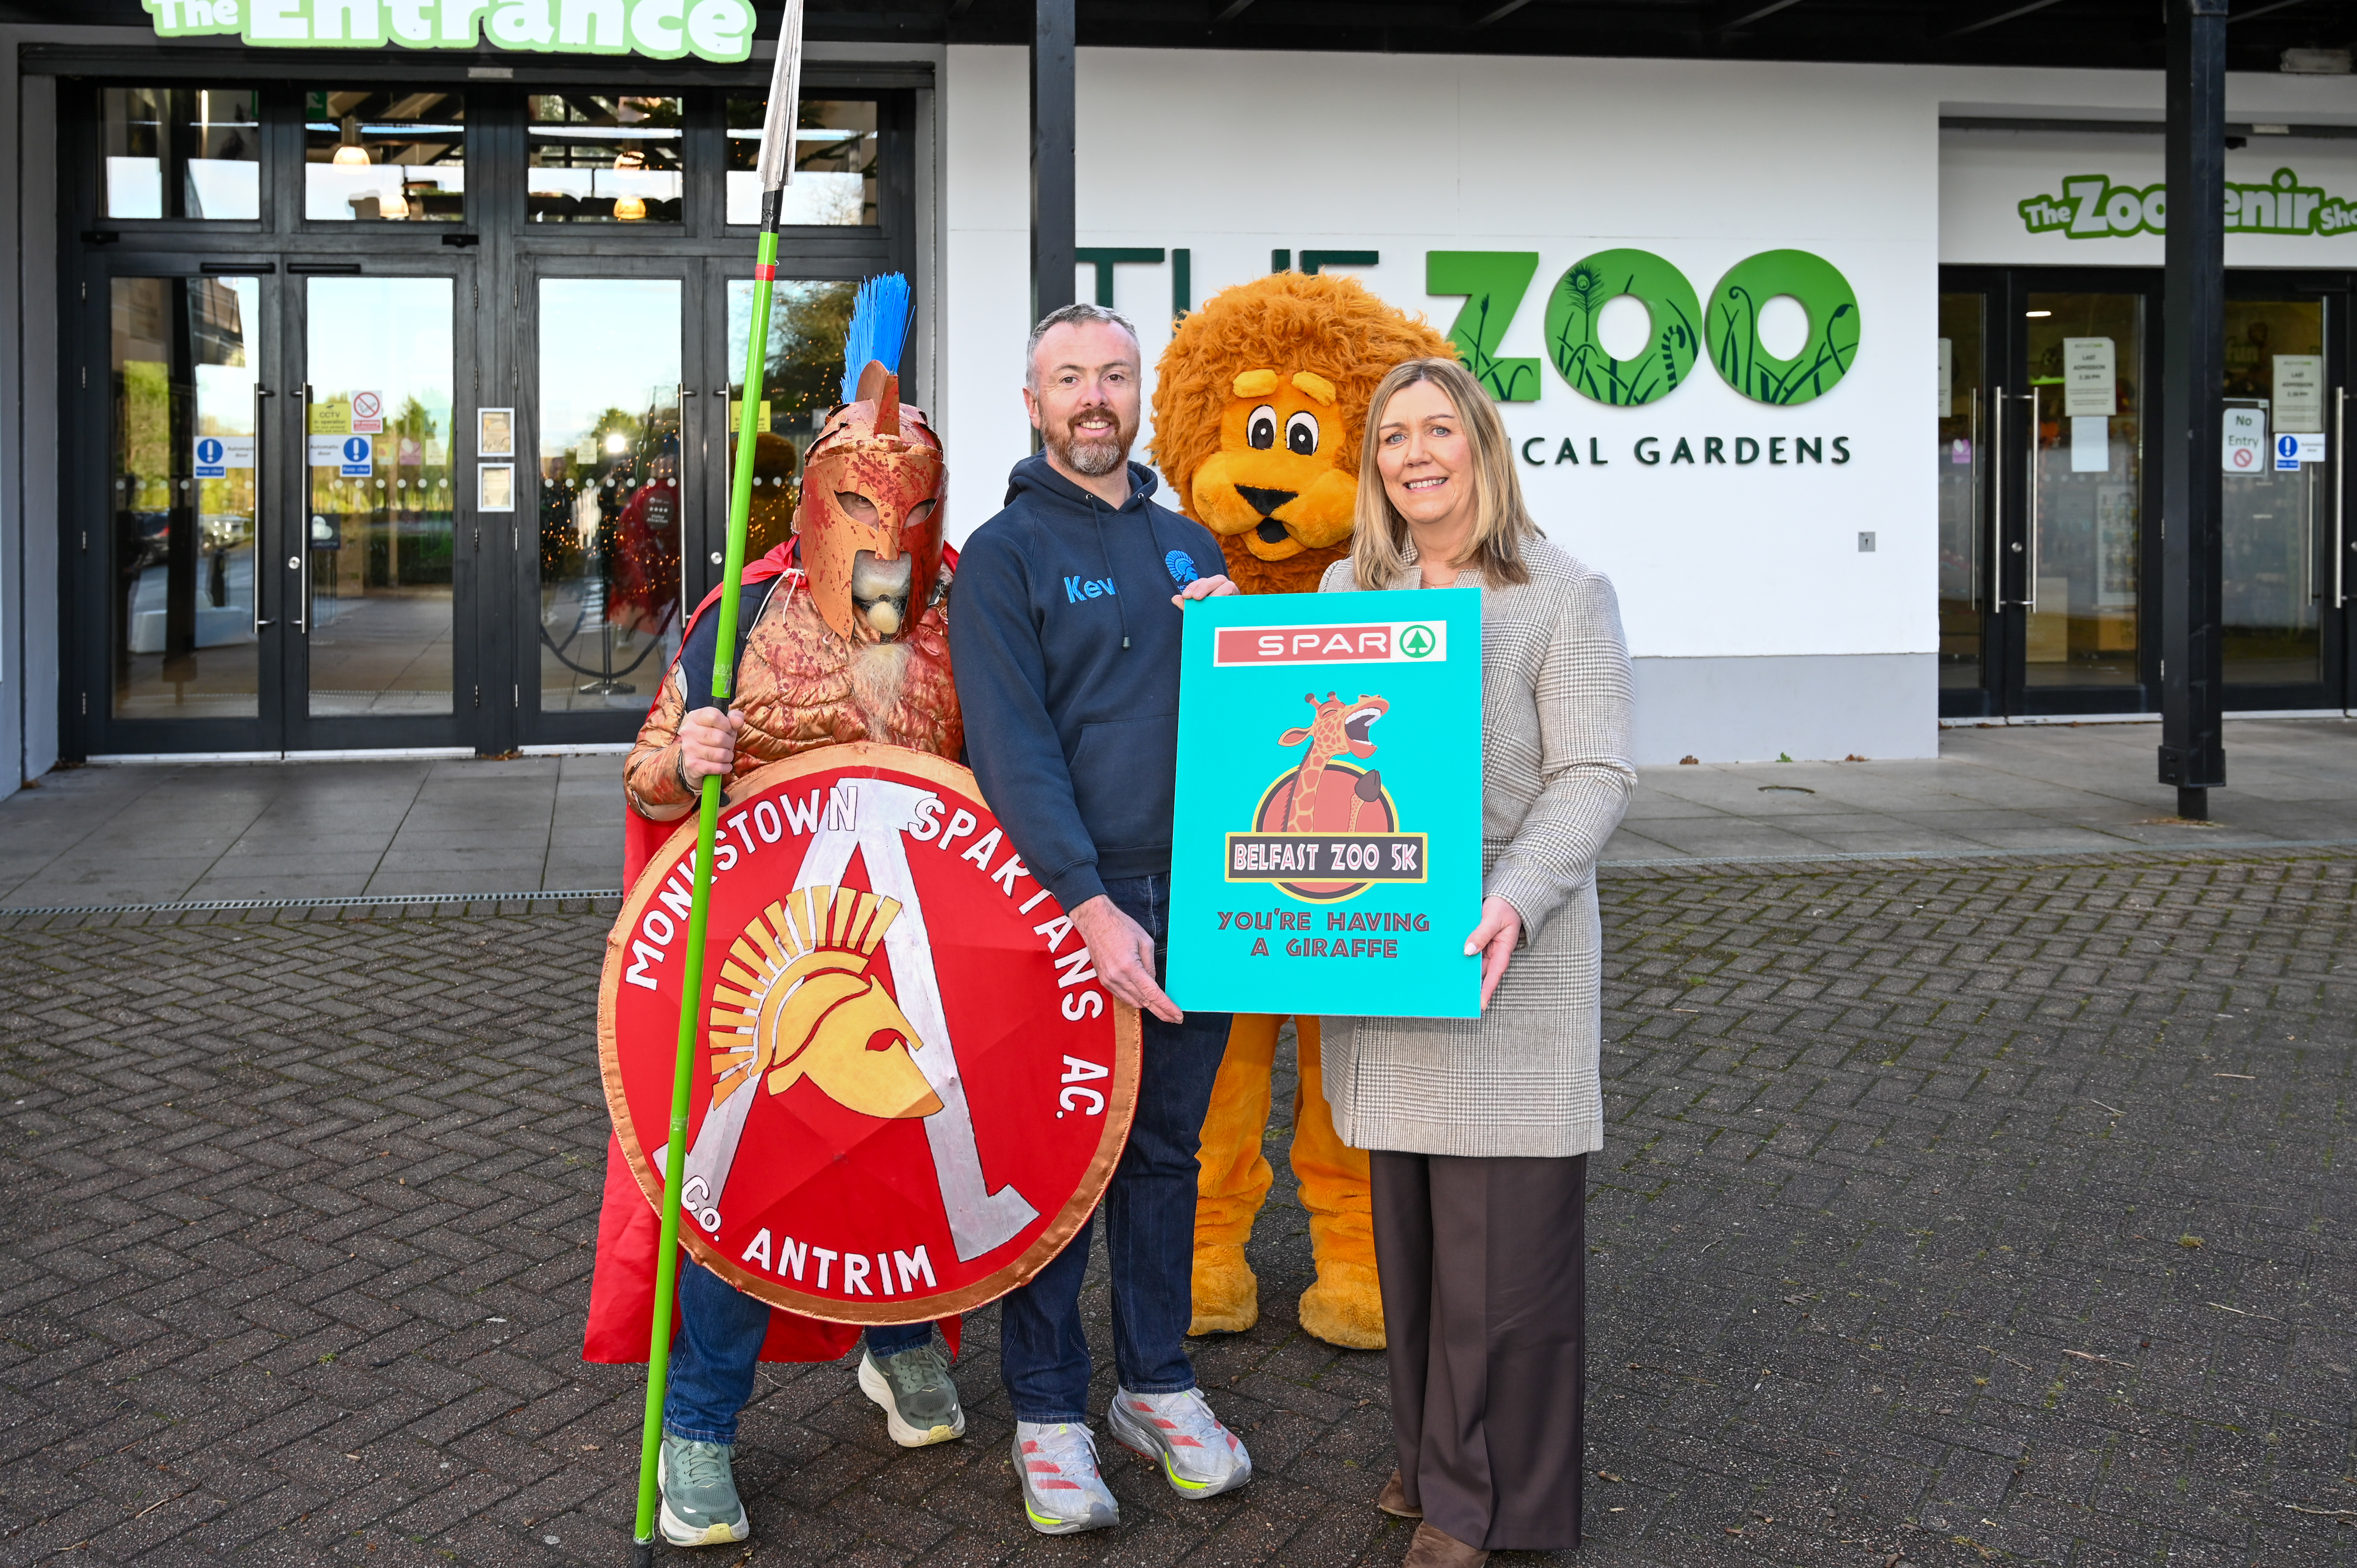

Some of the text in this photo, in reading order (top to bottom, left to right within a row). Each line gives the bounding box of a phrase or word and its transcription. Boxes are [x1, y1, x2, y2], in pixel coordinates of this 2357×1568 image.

[151, 0, 748, 54] The Entrance
[2025, 201, 2071, 227] The
[1426, 248, 1861, 406] ZOO
[2236, 415, 2252, 426] No
[1634, 437, 1850, 465] GARDENS
[2228, 435, 2259, 448] Entry
[1064, 576, 1116, 604] Kev
[1258, 632, 1386, 655] SPAR
[1234, 843, 1418, 871] BELFAST ZOO 5K
[1217, 908, 1430, 932] YOU'RE HAVING
[1250, 937, 1398, 958] A GIRAFFE
[742, 1226, 937, 1296] ANTRIM
